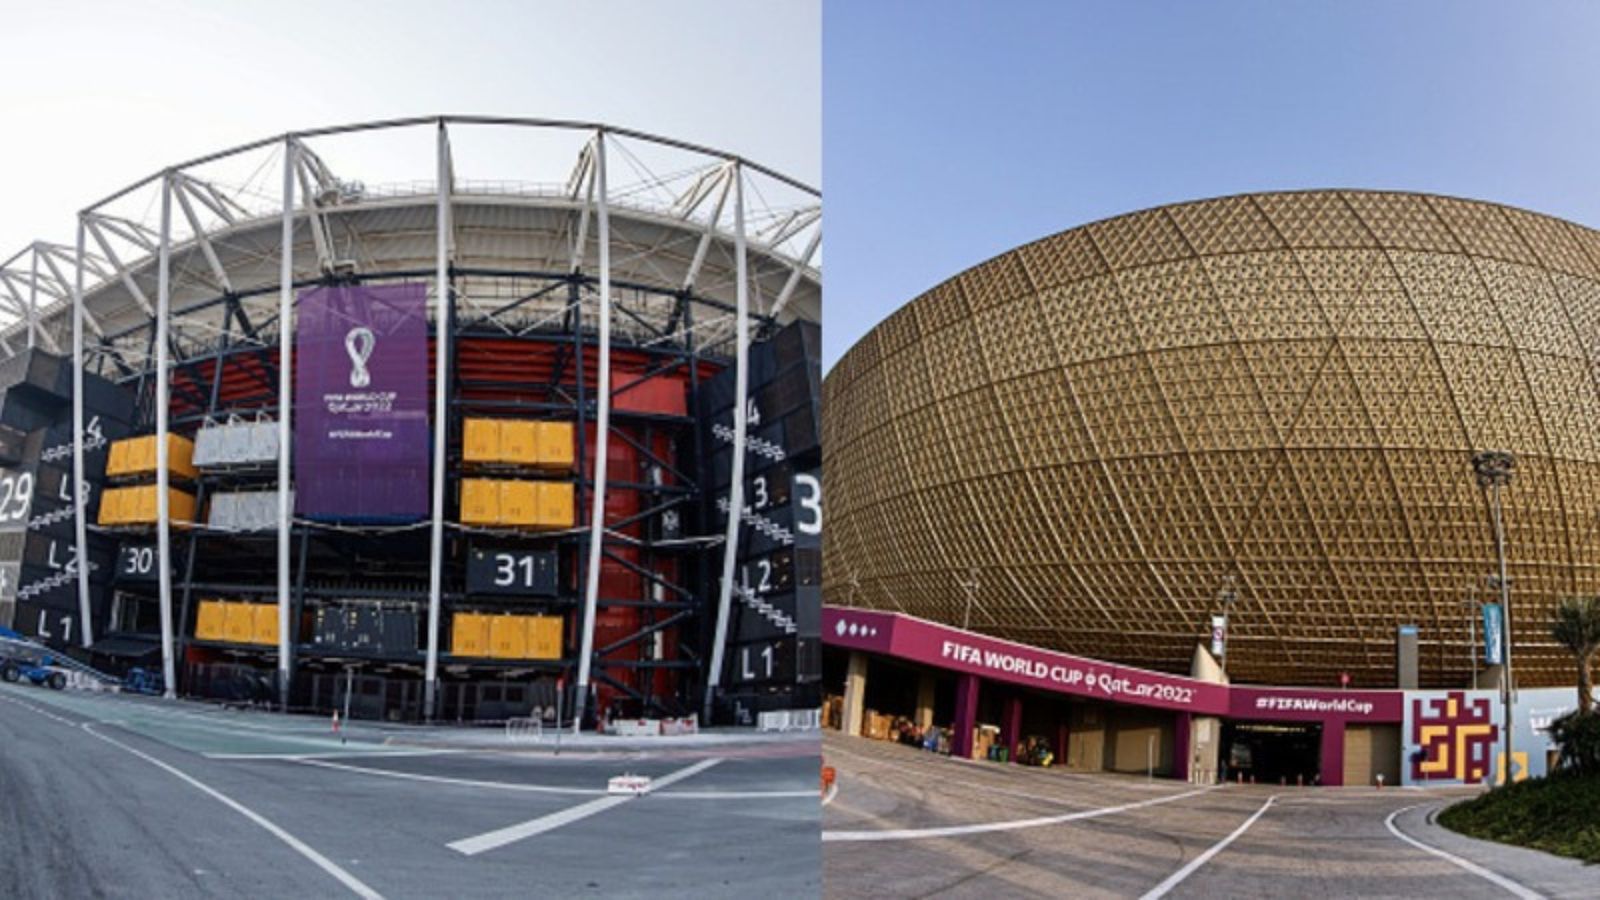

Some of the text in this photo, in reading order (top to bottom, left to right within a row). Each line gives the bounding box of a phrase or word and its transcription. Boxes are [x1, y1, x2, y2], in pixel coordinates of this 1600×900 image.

[0, 472, 34, 521] 29
[795, 473, 822, 535] 3
[126, 547, 153, 573] 30
[495, 553, 534, 587] 31
[942, 641, 982, 667] FIFA
[983, 650, 1048, 679] WORLD
[1050, 666, 1083, 685] CUP
[1256, 697, 1374, 714] #FIFAWorldCup
